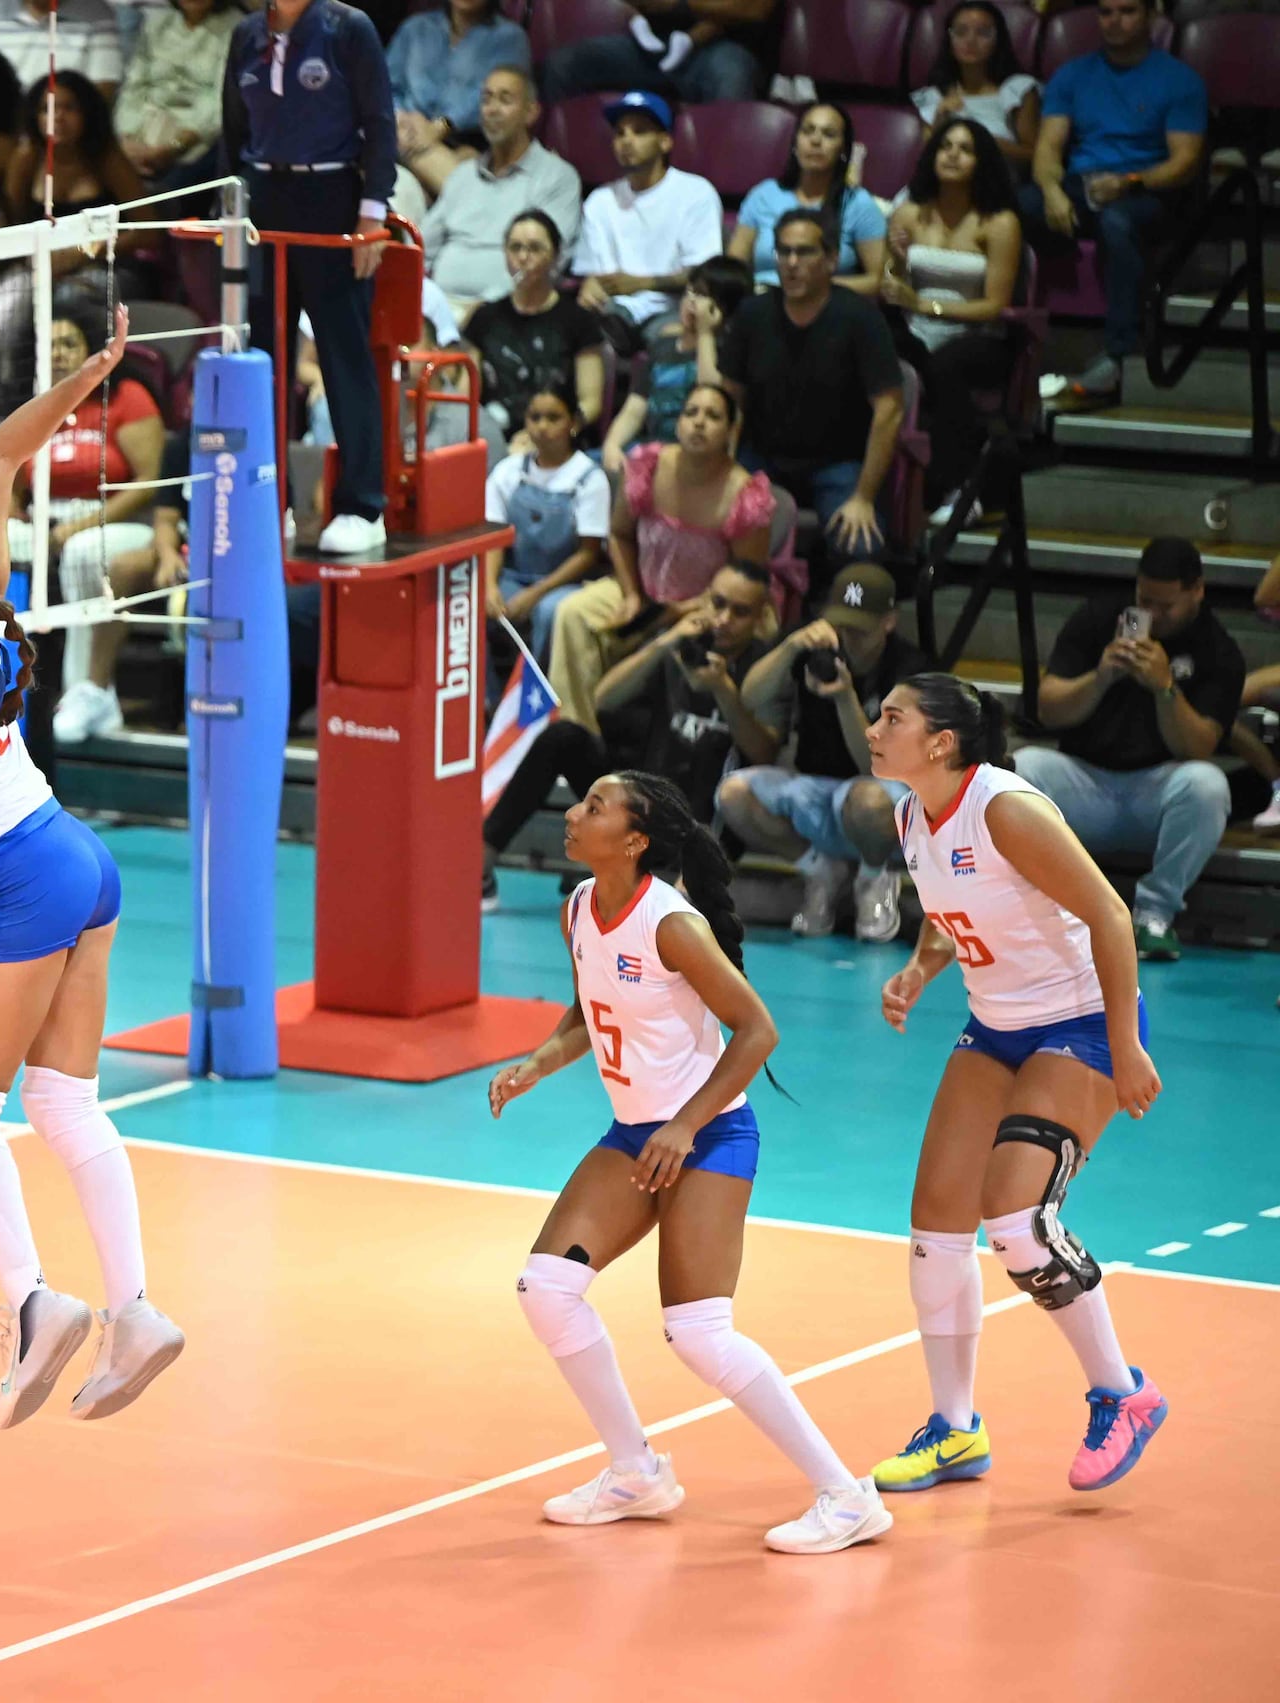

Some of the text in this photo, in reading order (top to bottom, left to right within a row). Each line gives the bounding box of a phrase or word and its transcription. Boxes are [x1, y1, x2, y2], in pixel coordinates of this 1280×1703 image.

[343, 721, 400, 742] Senoh
[954, 867, 976, 877] PUR
[618, 973, 642, 984] PUR
[589, 999, 623, 1071] 5
